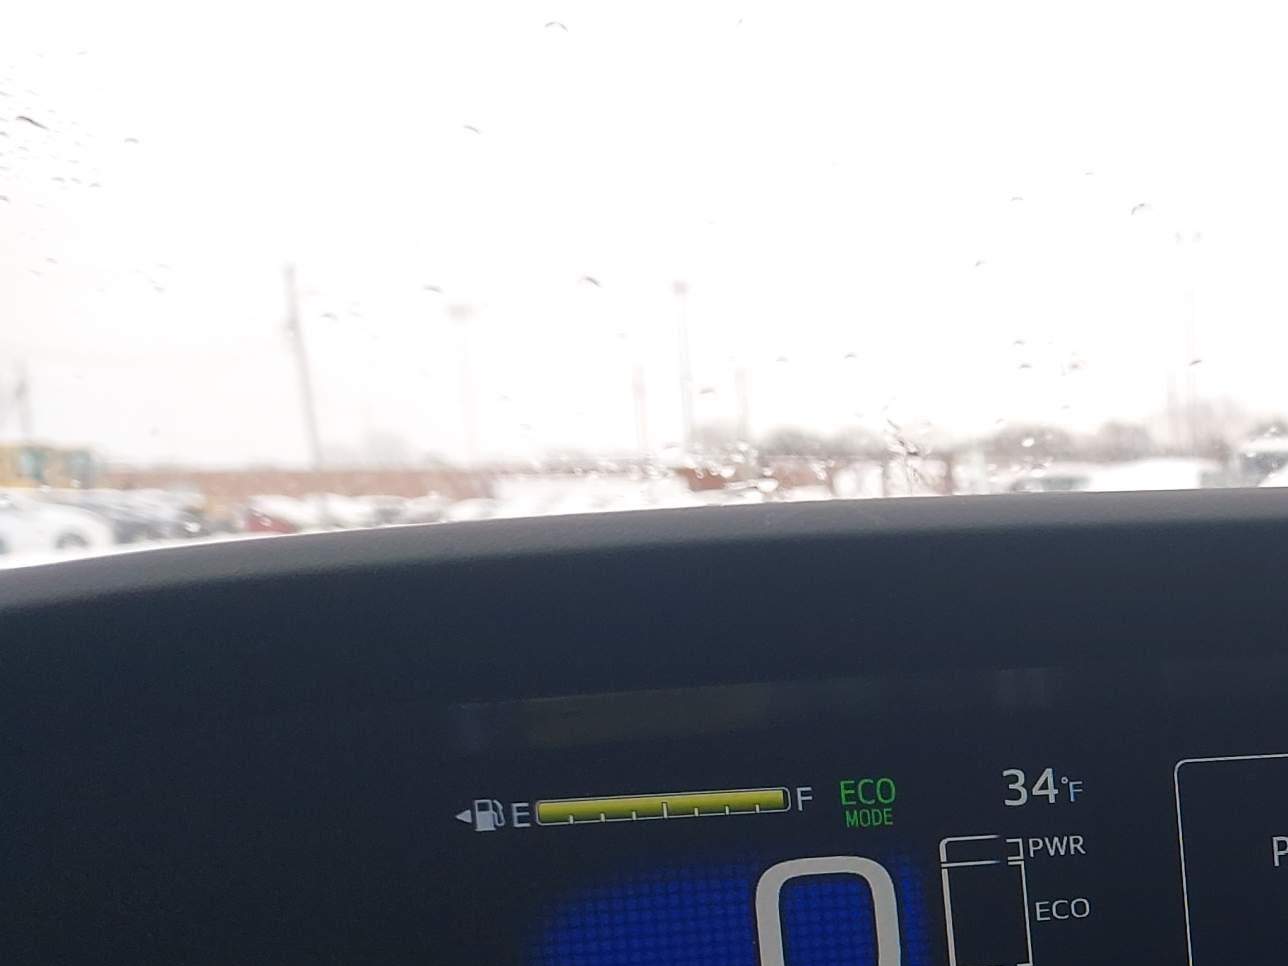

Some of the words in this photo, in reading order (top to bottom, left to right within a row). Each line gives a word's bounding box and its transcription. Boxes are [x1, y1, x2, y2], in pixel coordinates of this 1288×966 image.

[797, 787, 813, 811] F
[840, 778, 895, 804] ECO
[512, 803, 531, 828] E
[844, 808, 895, 827] MODE
[1029, 836, 1086, 857] PWR
[1036, 898, 1089, 921] ECO
